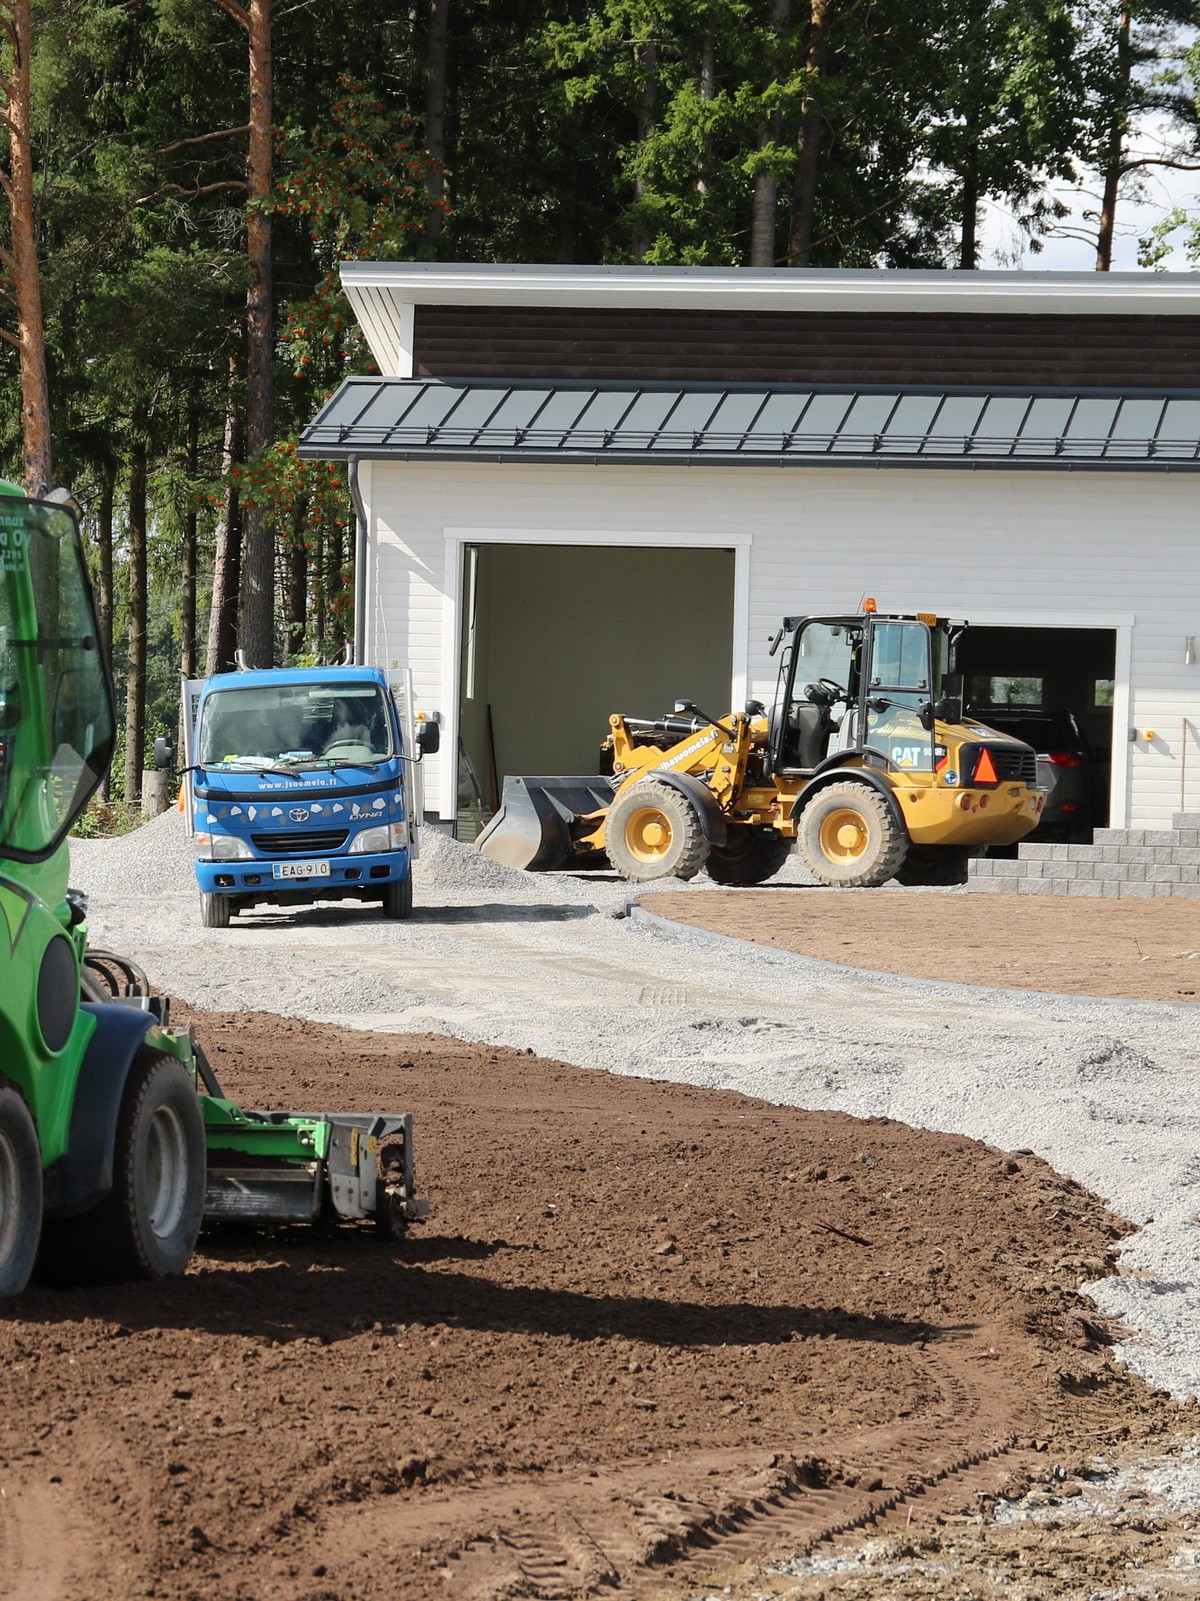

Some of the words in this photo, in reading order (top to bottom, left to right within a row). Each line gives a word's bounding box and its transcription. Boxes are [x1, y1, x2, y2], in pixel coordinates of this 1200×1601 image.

[891, 747, 921, 766] CAT
[349, 811, 383, 821] DYNA
[282, 863, 327, 876] EAG-910
